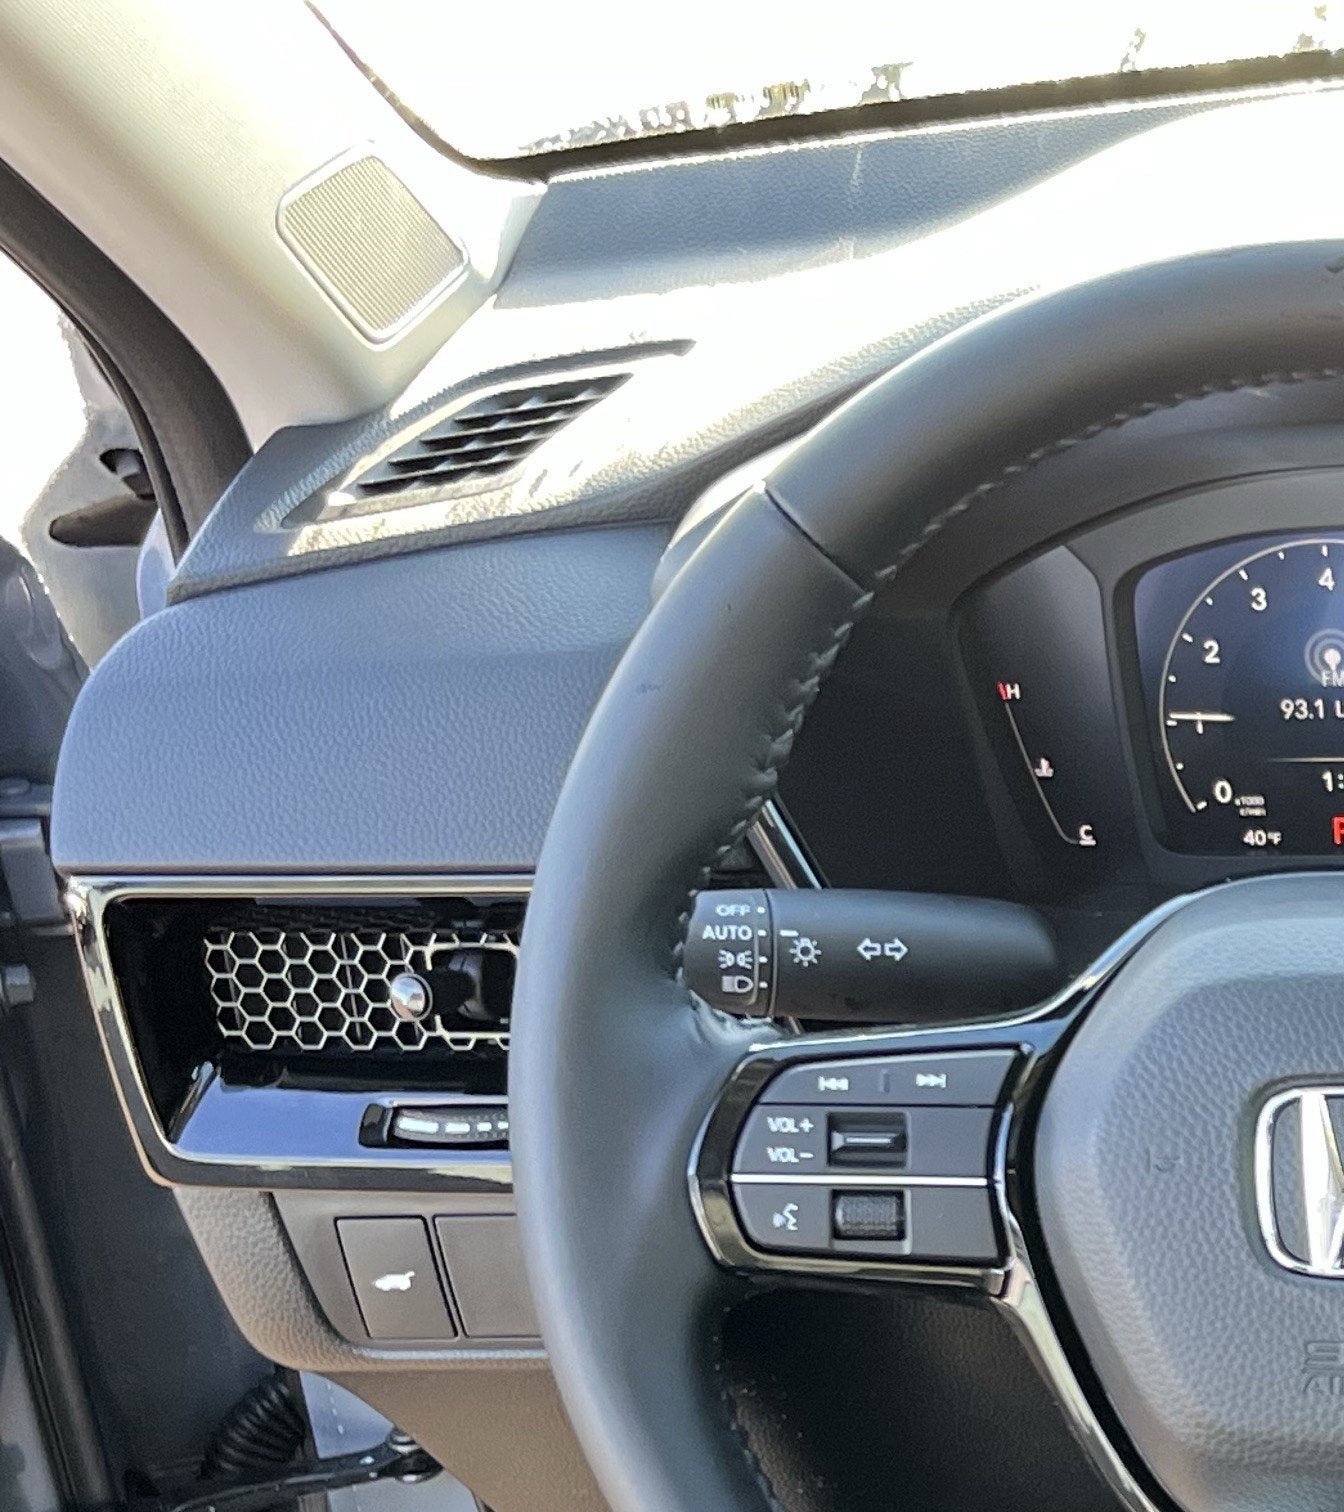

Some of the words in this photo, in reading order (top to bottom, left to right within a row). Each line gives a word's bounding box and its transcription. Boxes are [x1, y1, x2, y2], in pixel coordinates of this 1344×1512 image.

[1318, 567, 1335, 591] 4
[1250, 586, 1268, 611] 3
[1203, 639, 1221, 664] 2
[1006, 683, 1021, 700] H
[1280, 699, 1326, 720] 93.1
[1213, 779, 1233, 804] 0
[1079, 824, 1093, 841] C
[715, 904, 751, 917] OFF
[702, 925, 752, 941] AUTO
